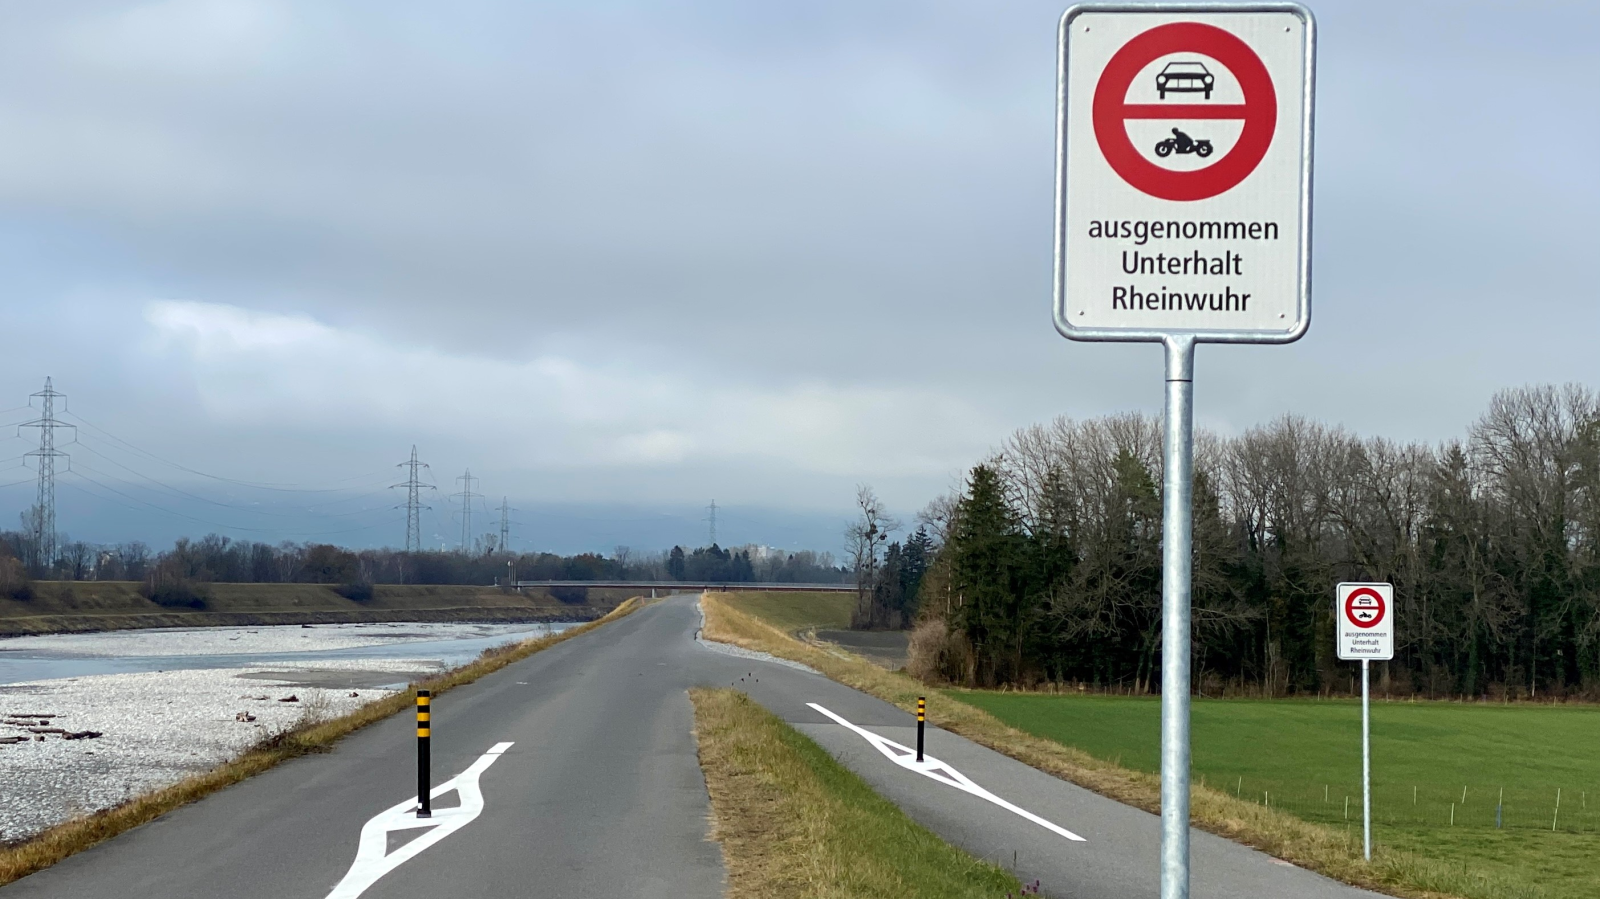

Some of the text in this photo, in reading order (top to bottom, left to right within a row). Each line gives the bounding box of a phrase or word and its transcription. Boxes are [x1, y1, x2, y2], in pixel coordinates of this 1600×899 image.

[1088, 220, 1279, 245] ausgenommen
[1122, 250, 1243, 275] Unterhalt
[1112, 285, 1251, 311] Rheinwuhr
